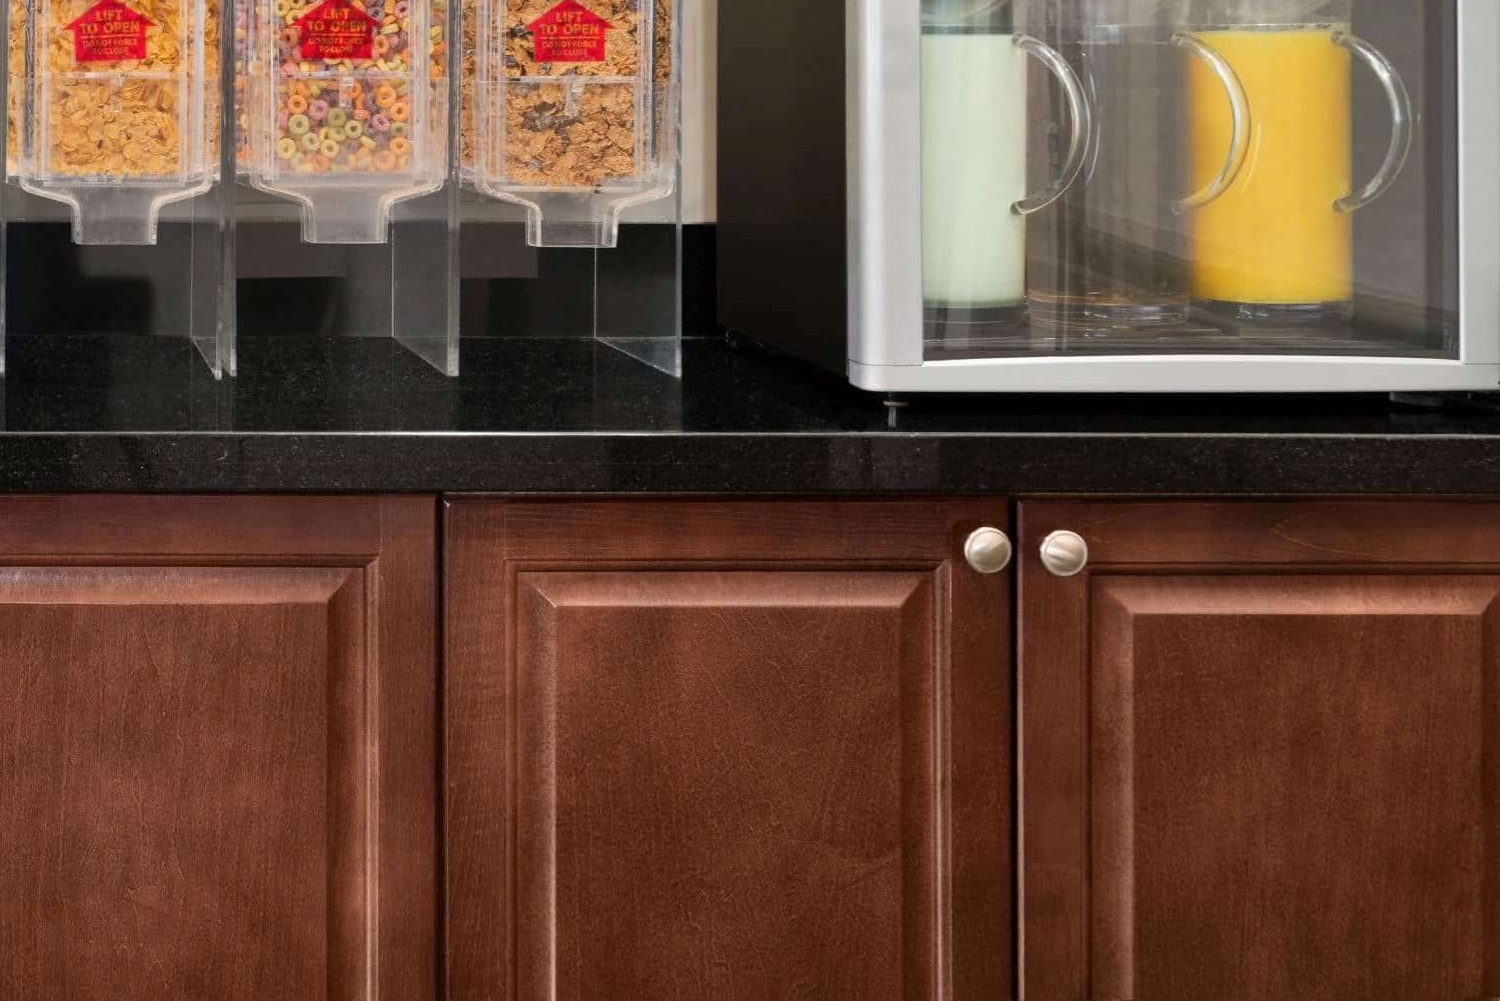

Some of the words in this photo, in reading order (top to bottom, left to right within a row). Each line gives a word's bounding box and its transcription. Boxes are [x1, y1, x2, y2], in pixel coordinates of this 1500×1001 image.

[96, 9, 124, 21] LIFT
[556, 11, 583, 23] LIFT
[80, 23, 98, 34] TO
[103, 22, 140, 34] OPEN
[307, 20, 324, 31] TO
[330, 20, 366, 32] OPEN
[541, 24, 558, 35] TO
[563, 23, 599, 35] OPEN
[573, 40, 597, 48] FORCE
